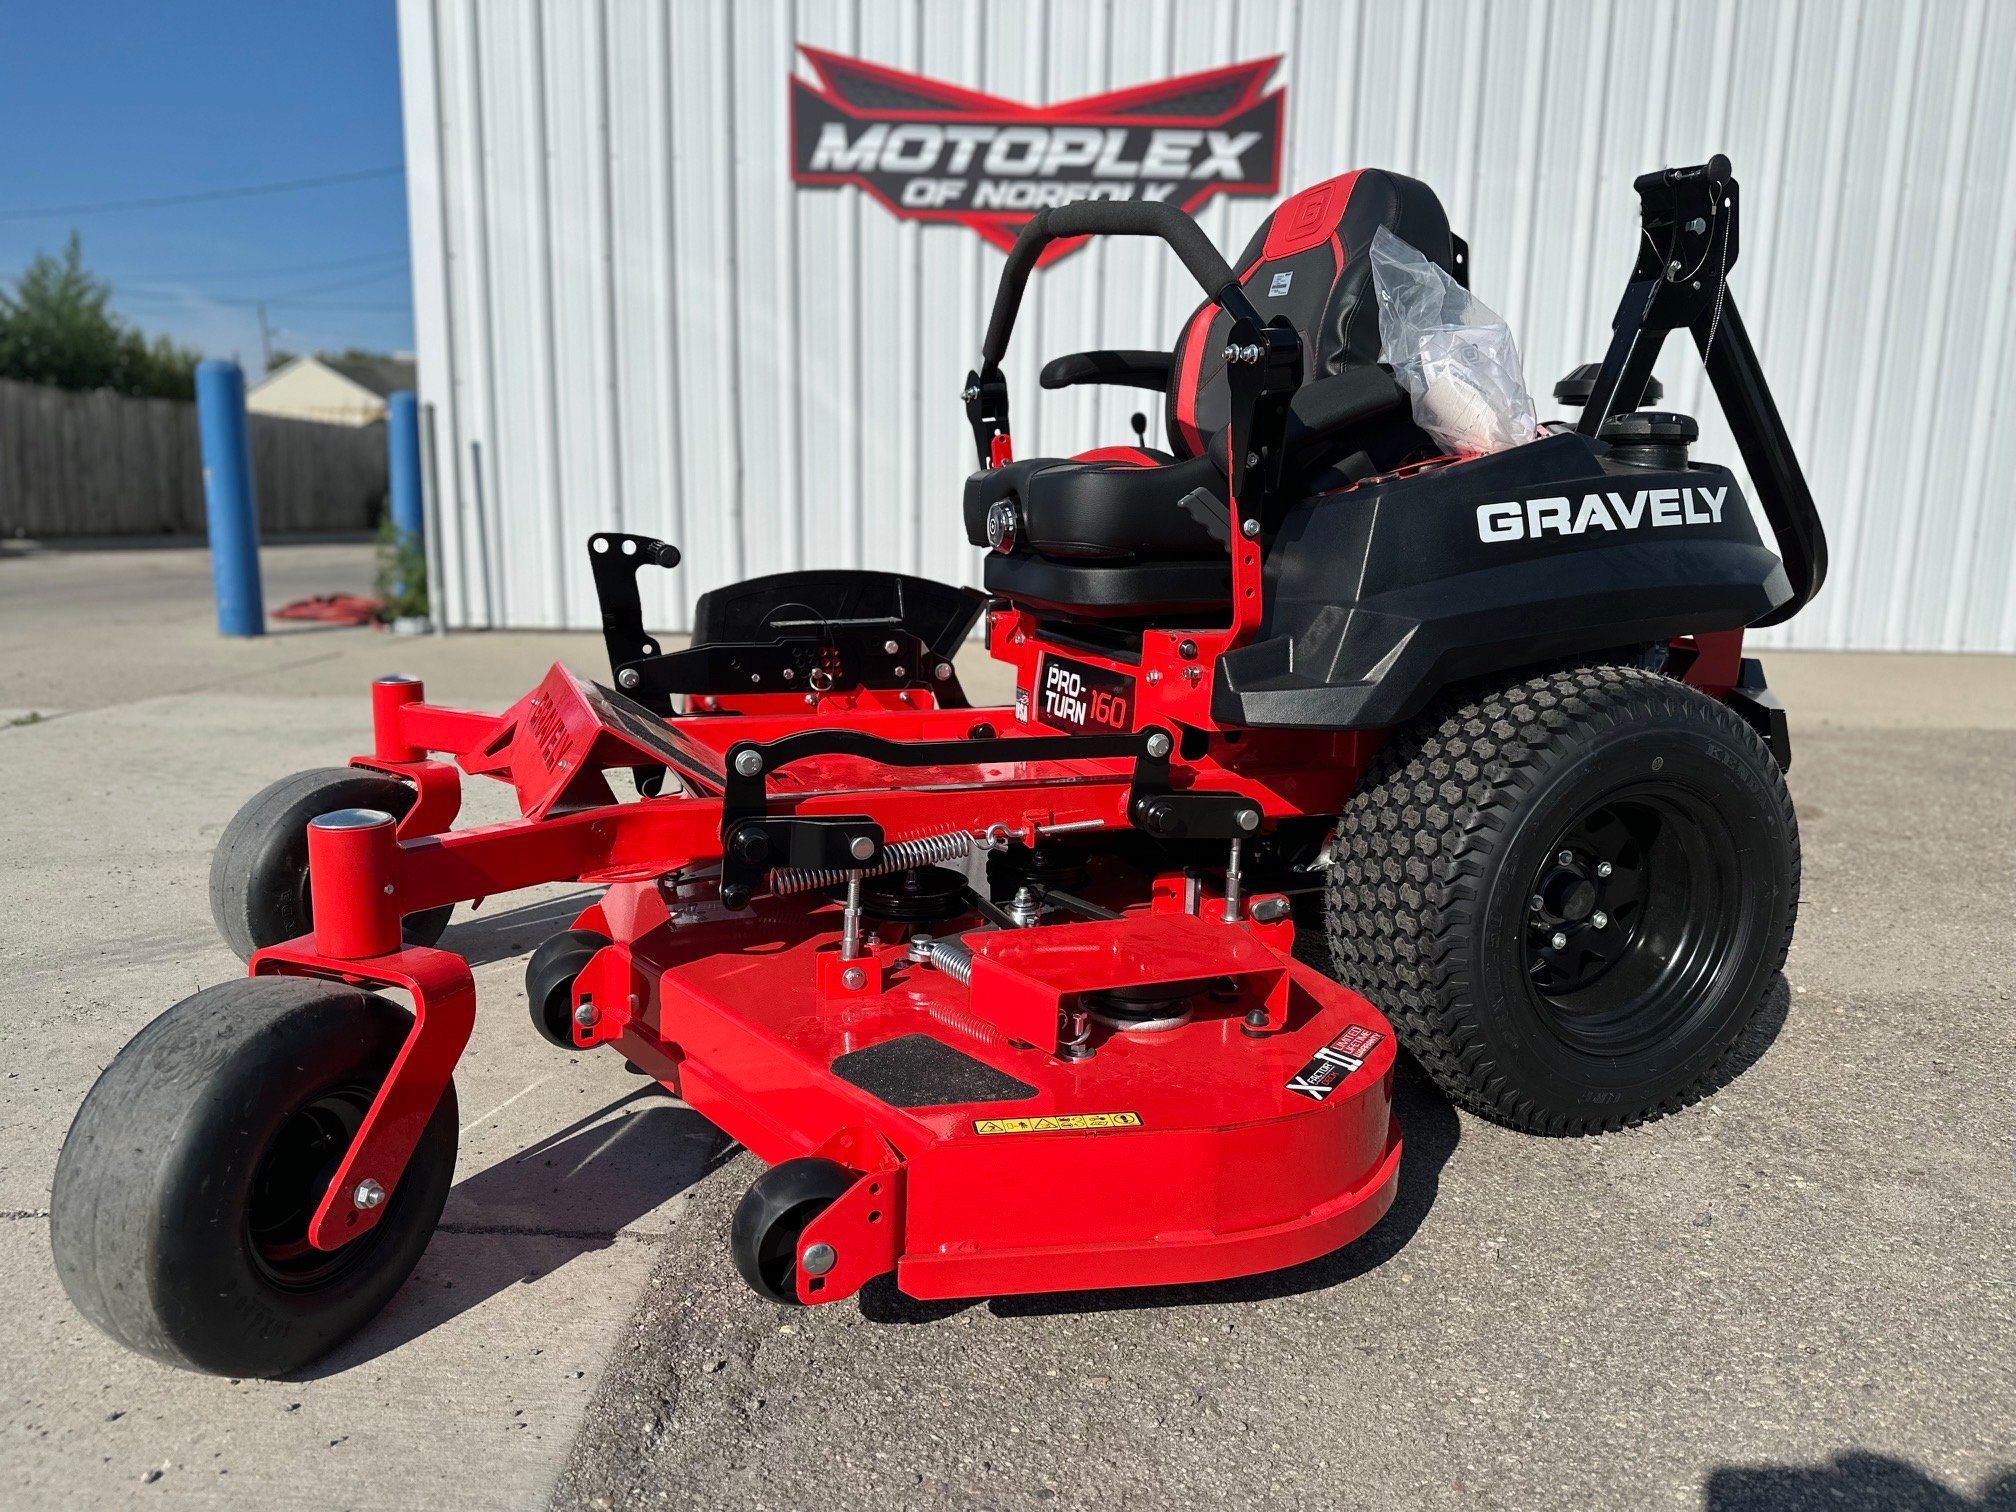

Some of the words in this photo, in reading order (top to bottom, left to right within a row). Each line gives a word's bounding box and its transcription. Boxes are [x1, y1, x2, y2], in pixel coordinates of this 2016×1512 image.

[810, 121, 1262, 179] MOTOPLEX
[901, 177, 968, 208] OF
[1476, 486, 1728, 544] GRAVELY
[1046, 667, 1087, 698] PRO-
[1045, 690, 1087, 725] TURN
[1090, 690, 1127, 728] 160
[530, 691, 574, 775] GRAVELY
[1286, 1075, 1333, 1101] X
[1306, 1061, 1333, 1084] FACTOR
